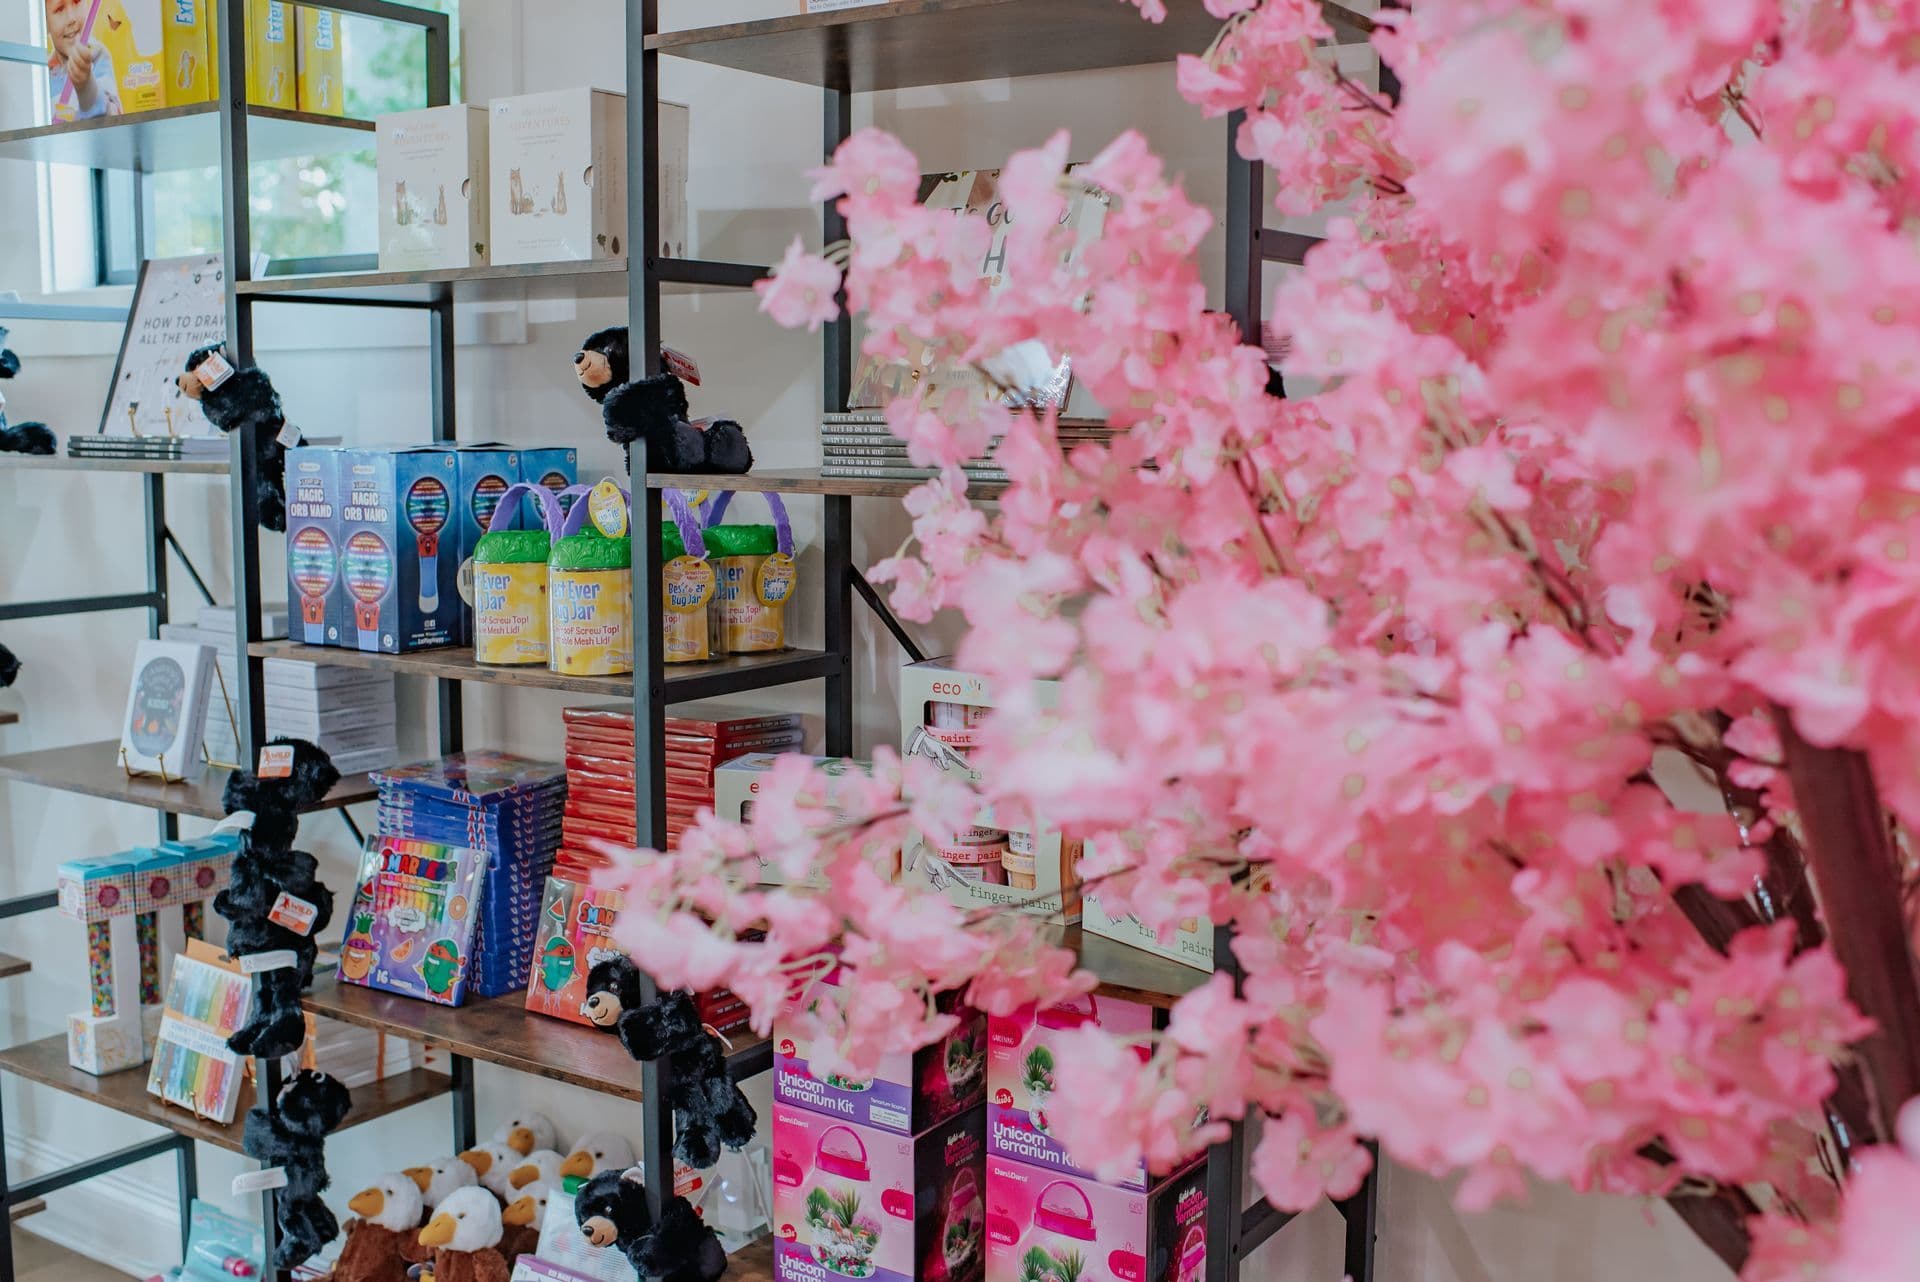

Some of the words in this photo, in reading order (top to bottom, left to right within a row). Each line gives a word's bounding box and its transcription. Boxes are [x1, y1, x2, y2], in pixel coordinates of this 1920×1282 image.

[143, 317, 173, 329] HOW
[175, 316, 191, 329] TO
[139, 334, 159, 345] ALL
[161, 333, 180, 344] THE
[297, 488, 325, 503] MAGIC
[352, 492, 379, 506] MAGIC
[291, 504, 308, 517] ORB
[309, 504, 332, 518] WAND
[344, 508, 362, 521] ORB
[363, 509, 388, 523] WAND
[482, 571, 511, 590] Ever
[568, 580, 600, 600] Ever
[486, 593, 506, 611] Jar
[671, 594, 686, 607] Bug
[687, 594, 702, 605] Jar
[555, 605, 569, 623] ug
[571, 602, 595, 621] Jar
[664, 614, 681, 624] Top!
[489, 617, 511, 625] Screw
[512, 615, 529, 626] Top!
[487, 626, 505, 635] Mesh
[506, 625, 520, 635] Lid!
[576, 626, 601, 635] Screw
[602, 625, 620, 636] Top!
[574, 636, 595, 645] Mesh
[596, 635, 610, 645] Lid!
[932, 681, 961, 695] eco
[940, 734, 972, 744] paint
[970, 886, 1013, 905] finger
[1021, 895, 1058, 912] paint
[778, 1070, 824, 1094] Unicorn
[779, 1087, 836, 1110] Terrarium
[837, 1099, 854, 1114] Kit
[993, 1122, 1046, 1147] Unicorn
[993, 1135, 1059, 1163] Terrarium
[779, 1253, 826, 1278] Unicorn
